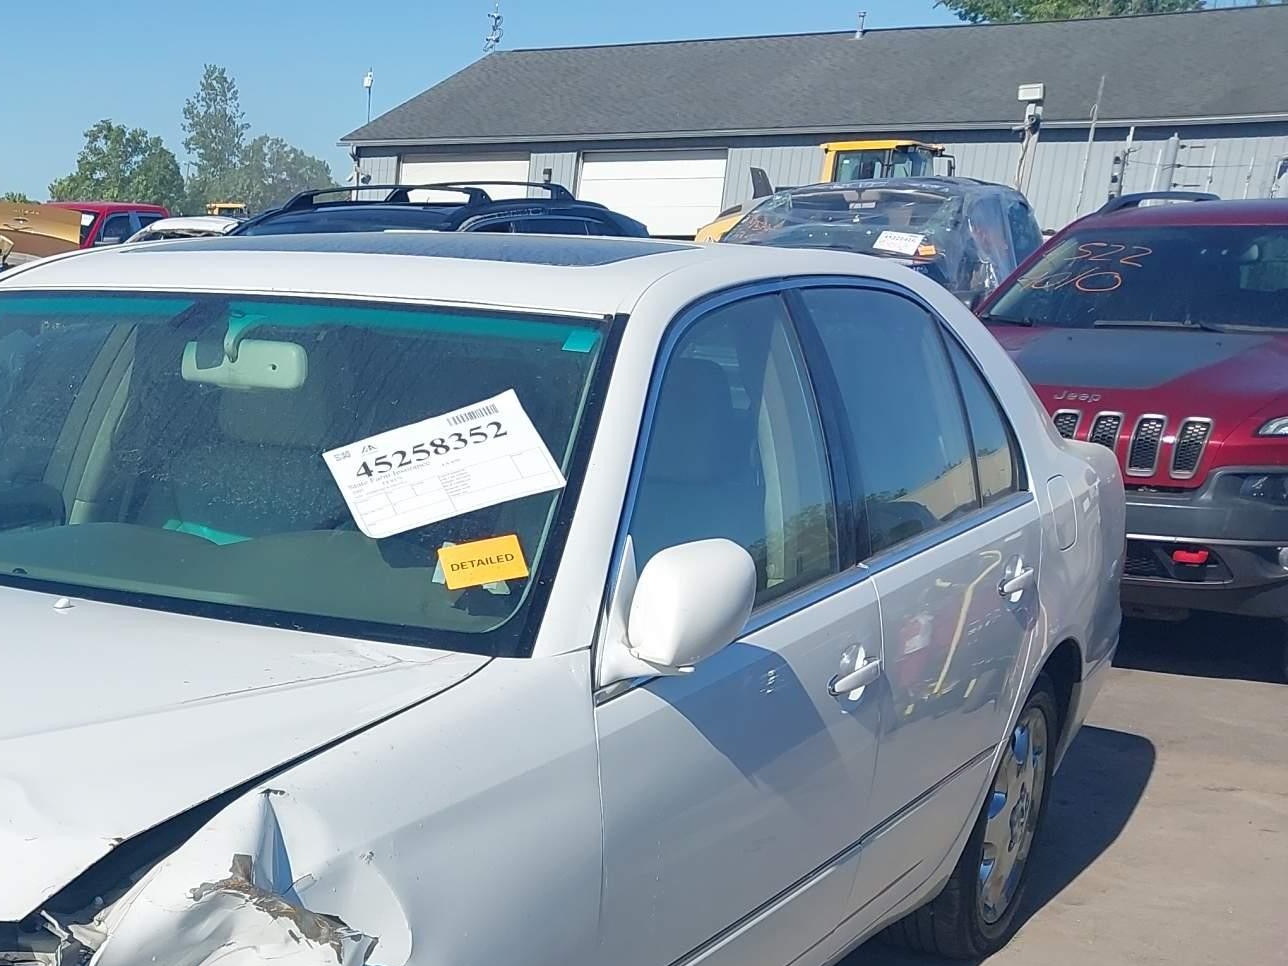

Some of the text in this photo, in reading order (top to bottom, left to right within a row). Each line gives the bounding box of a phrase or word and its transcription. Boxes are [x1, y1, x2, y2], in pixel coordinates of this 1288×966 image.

[1053, 390, 1102, 403] Jeep
[355, 421, 508, 478] 45258352
[450, 553, 515, 573] DETAILED
